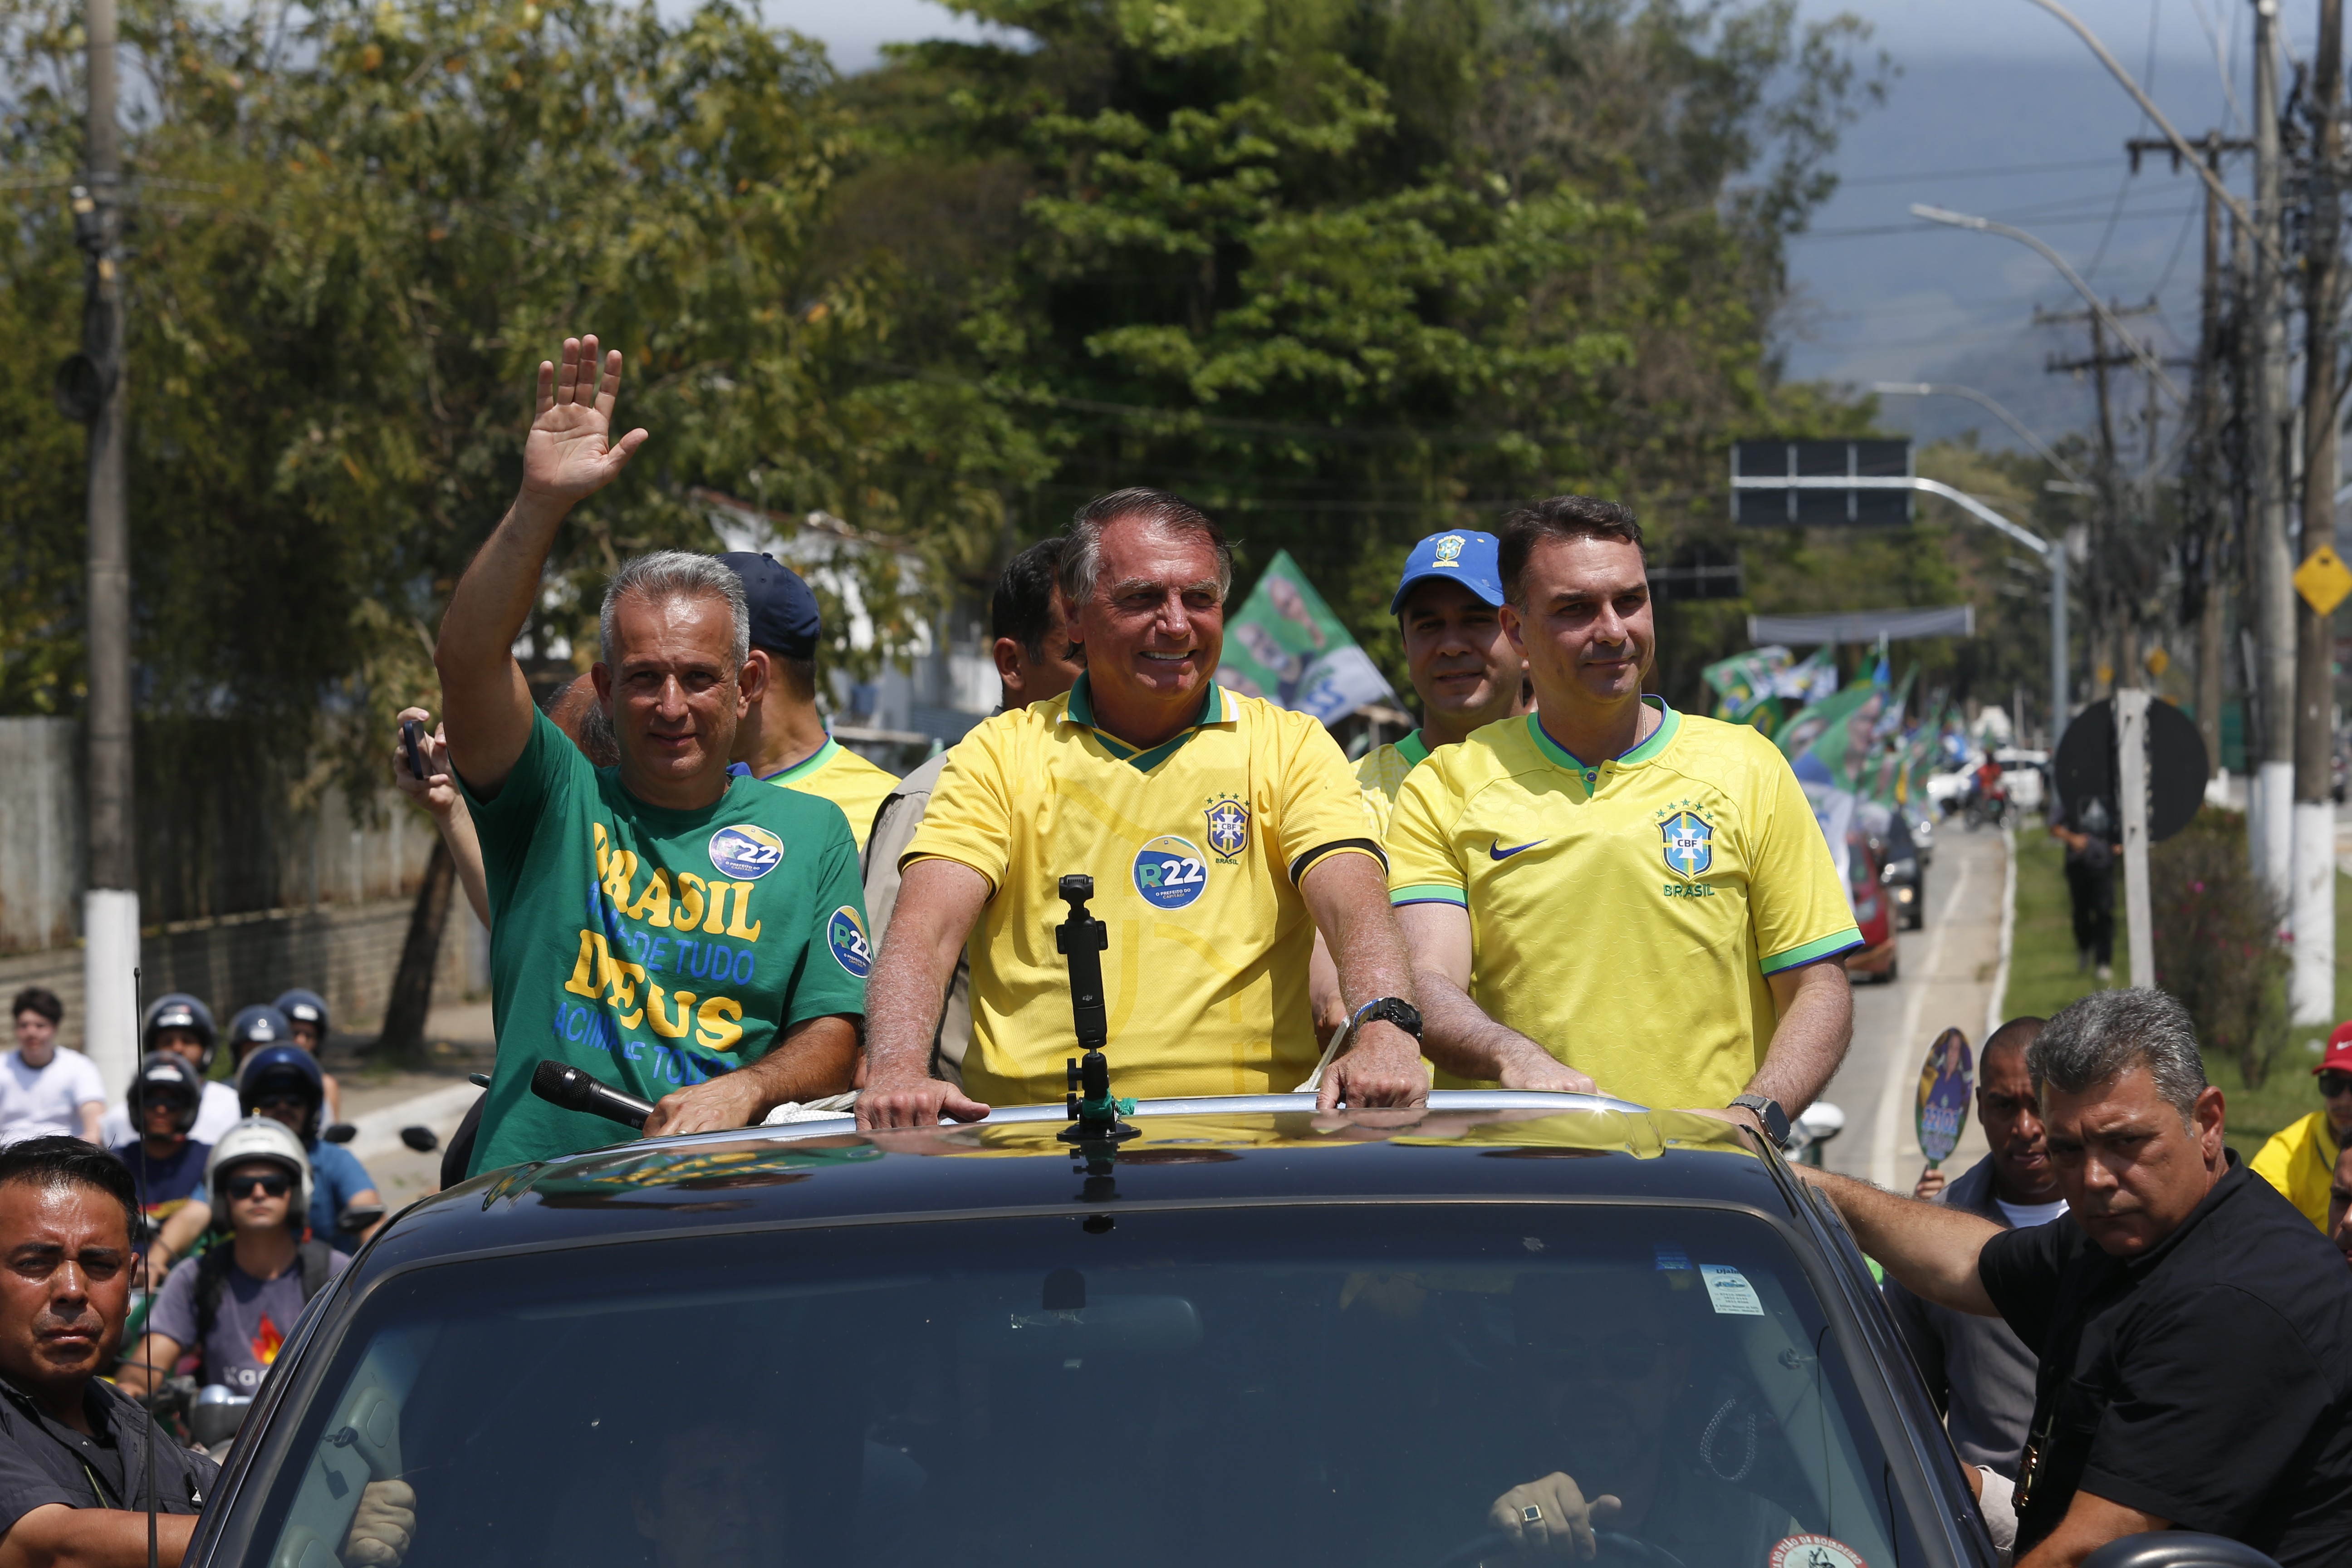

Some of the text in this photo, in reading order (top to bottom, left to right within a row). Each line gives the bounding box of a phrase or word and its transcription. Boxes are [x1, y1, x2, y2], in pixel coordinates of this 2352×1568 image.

[1677, 839, 1697, 848] CBF
[593, 823, 761, 942] BRASIL
[1664, 884, 1715, 897] BRASIL
[632, 931, 670, 970] DE
[676, 939, 755, 985] TUDO
[564, 929, 743, 1052] DEUS
[553, 1002, 619, 1054] ACIMA
